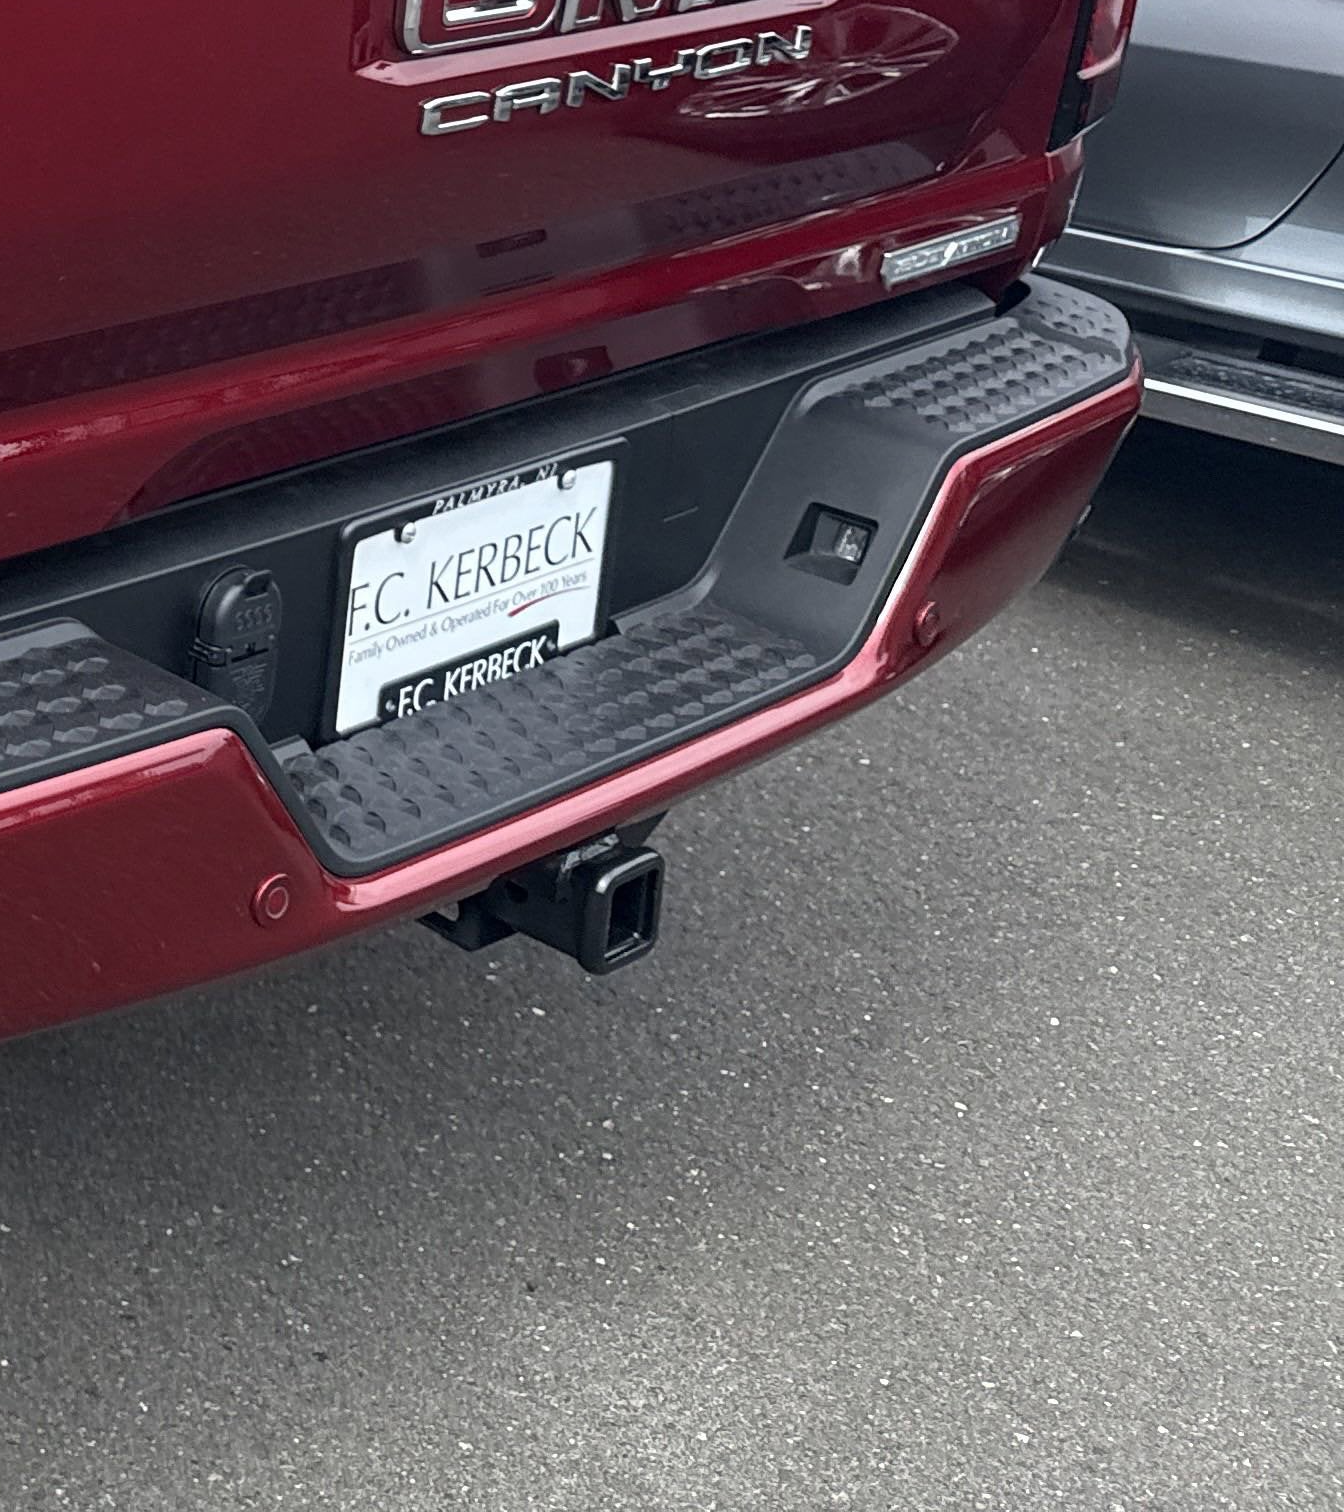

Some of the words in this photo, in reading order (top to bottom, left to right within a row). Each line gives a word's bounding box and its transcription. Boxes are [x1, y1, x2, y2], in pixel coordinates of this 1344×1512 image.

[419, 24, 811, 136] CANYON
[348, 571, 410, 637] F.C.
[427, 506, 597, 610] KERBECK
[348, 641, 384, 667] Family
[385, 625, 428, 652] Owned
[429, 620, 438, 636] &
[440, 601, 491, 635] Operated
[492, 596, 509, 614] For
[512, 589, 537, 607] Over
[539, 580, 558, 597] 100
[561, 570, 587, 589] Years
[443, 635, 547, 702] KERBECK
